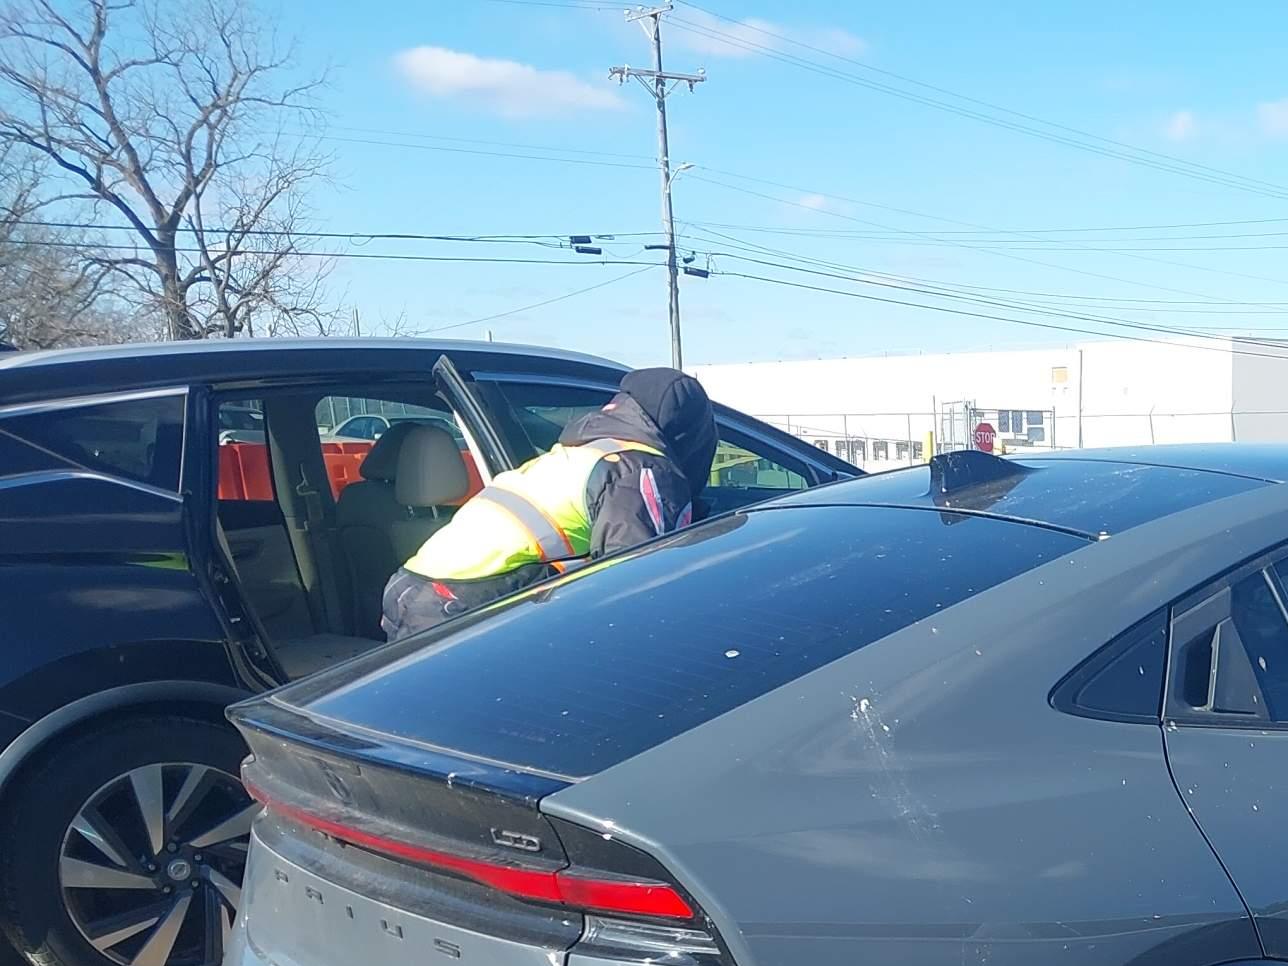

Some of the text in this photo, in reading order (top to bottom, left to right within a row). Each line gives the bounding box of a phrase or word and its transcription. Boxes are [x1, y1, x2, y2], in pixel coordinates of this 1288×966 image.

[976, 431, 995, 443] STOP
[490, 828, 540, 851] LTD
[274, 869, 461, 961] PRIUS
